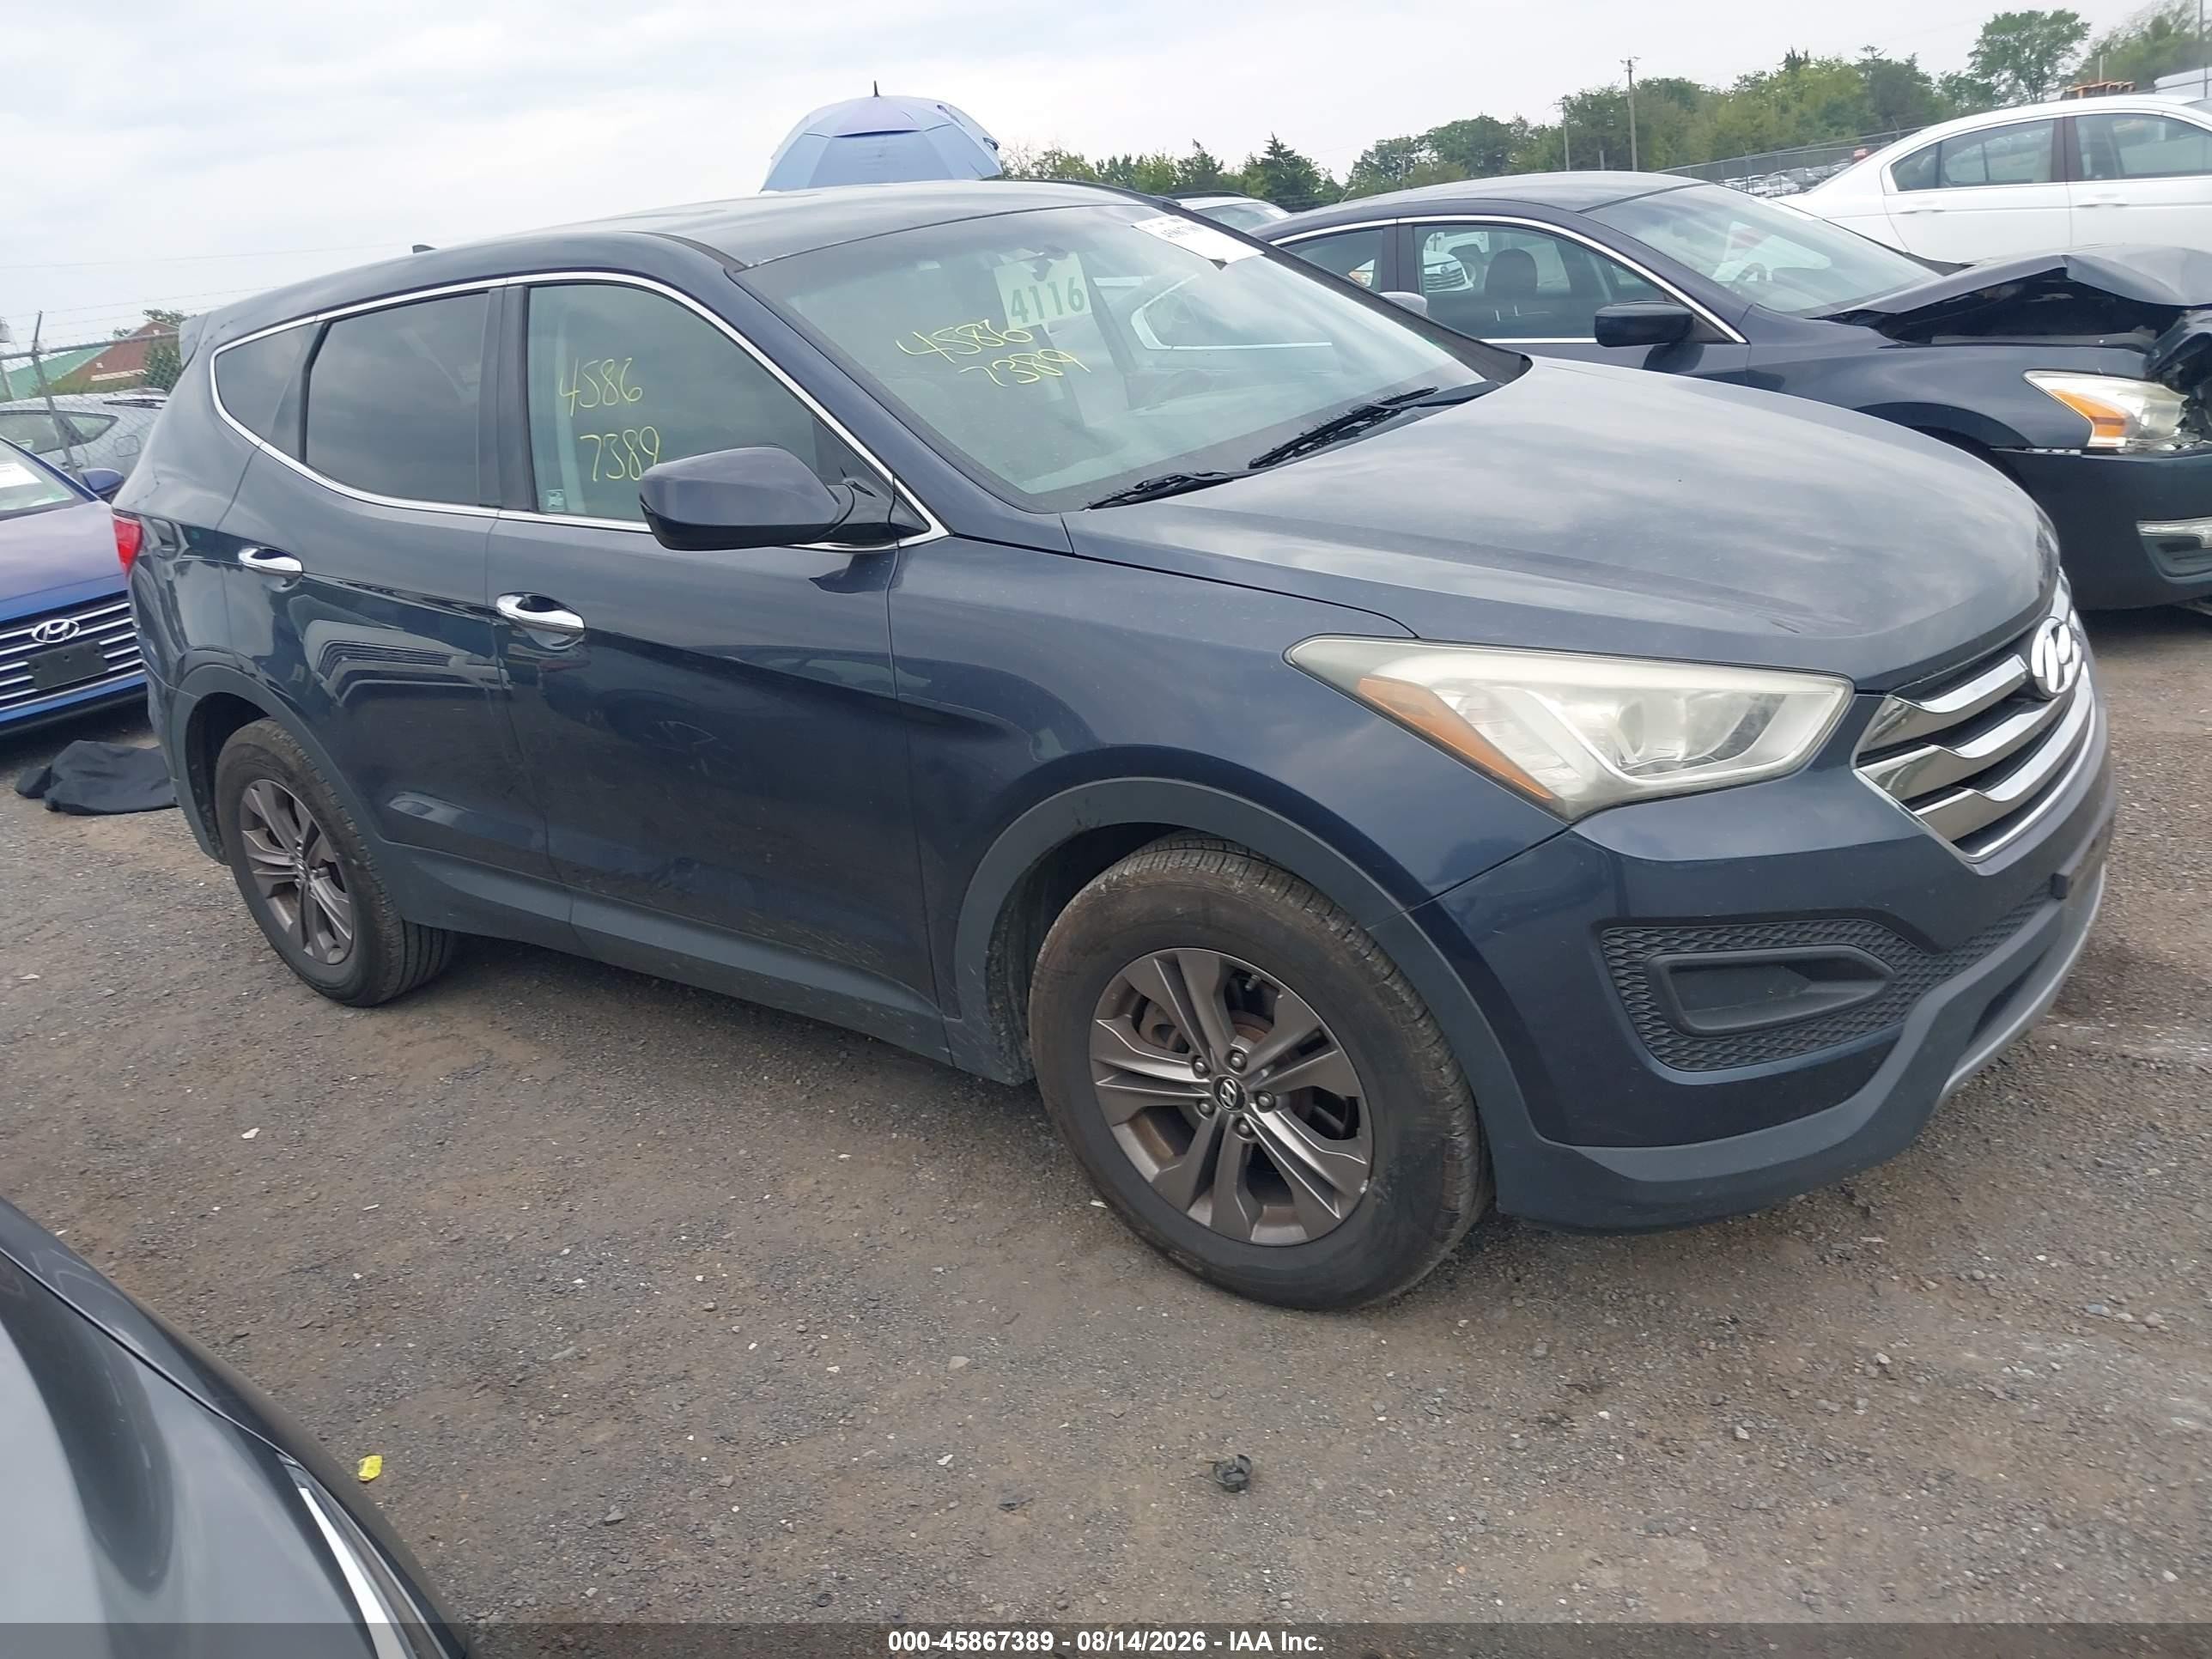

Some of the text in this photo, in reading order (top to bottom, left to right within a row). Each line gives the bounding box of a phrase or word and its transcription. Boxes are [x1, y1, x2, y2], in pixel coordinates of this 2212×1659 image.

[1010, 276, 1085, 324] 4116
[895, 319, 1034, 364] 4586
[559, 357, 643, 417] 4586
[958, 349, 1091, 387] 7389
[579, 426, 660, 482] 7389
